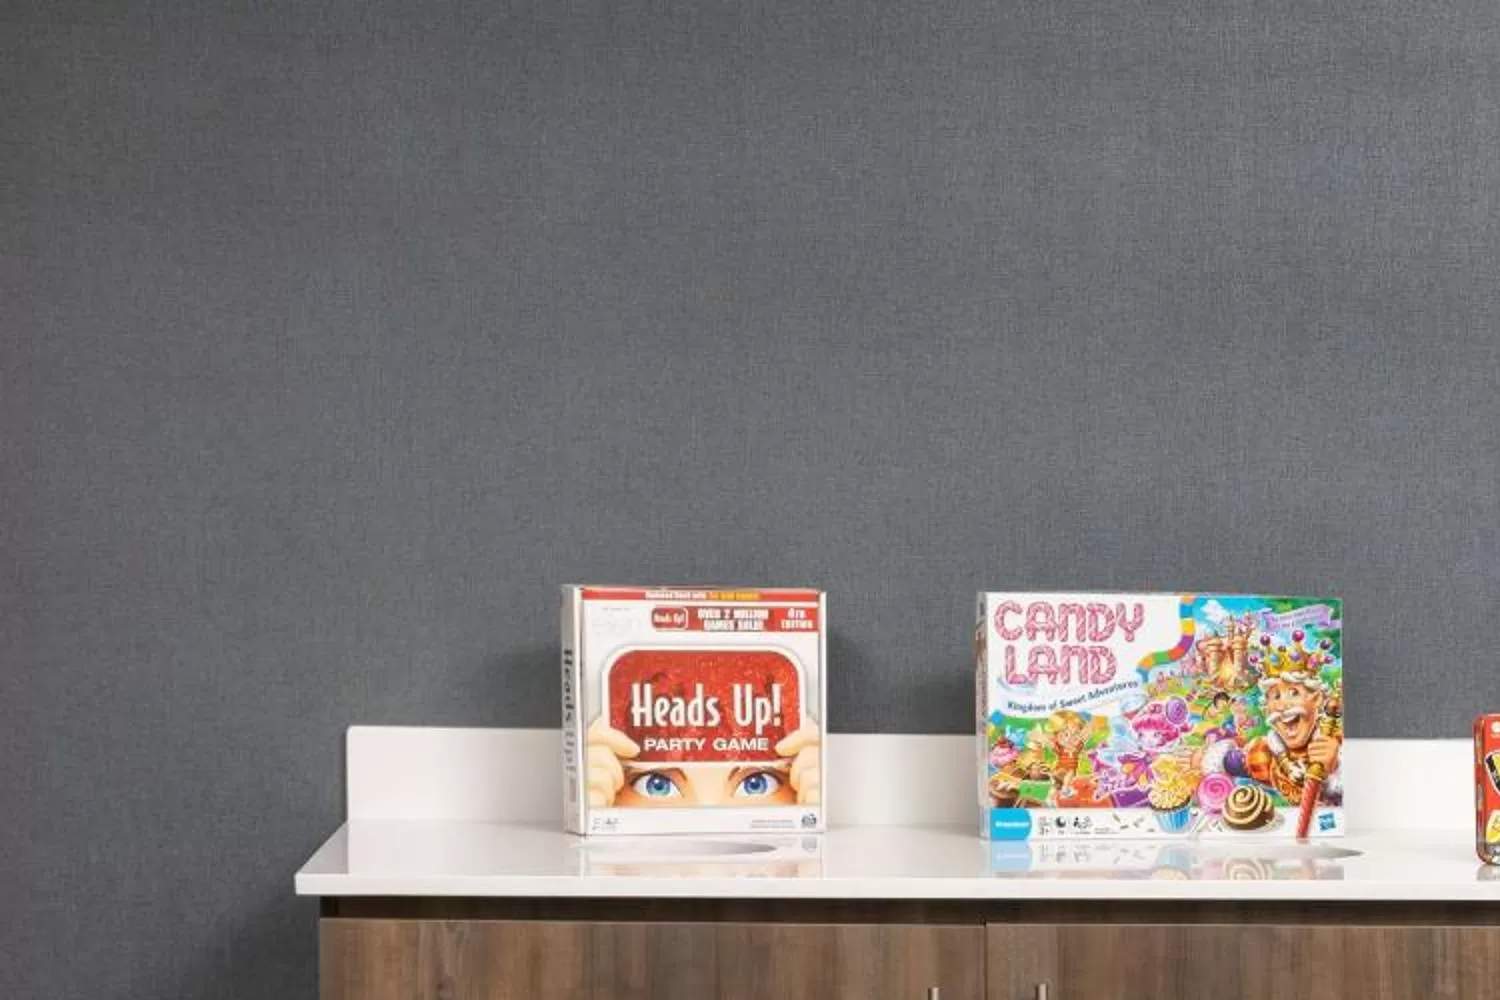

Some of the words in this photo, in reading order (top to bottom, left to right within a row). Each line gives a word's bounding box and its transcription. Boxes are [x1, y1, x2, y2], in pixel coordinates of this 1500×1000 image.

[994, 600, 1144, 642] CANDY
[1005, 644, 1117, 685] LAND
[631, 683, 720, 727] Heads
[732, 683, 782, 735] Up!
[643, 737, 706, 751] PARTY
[712, 737, 769, 751] GAME
